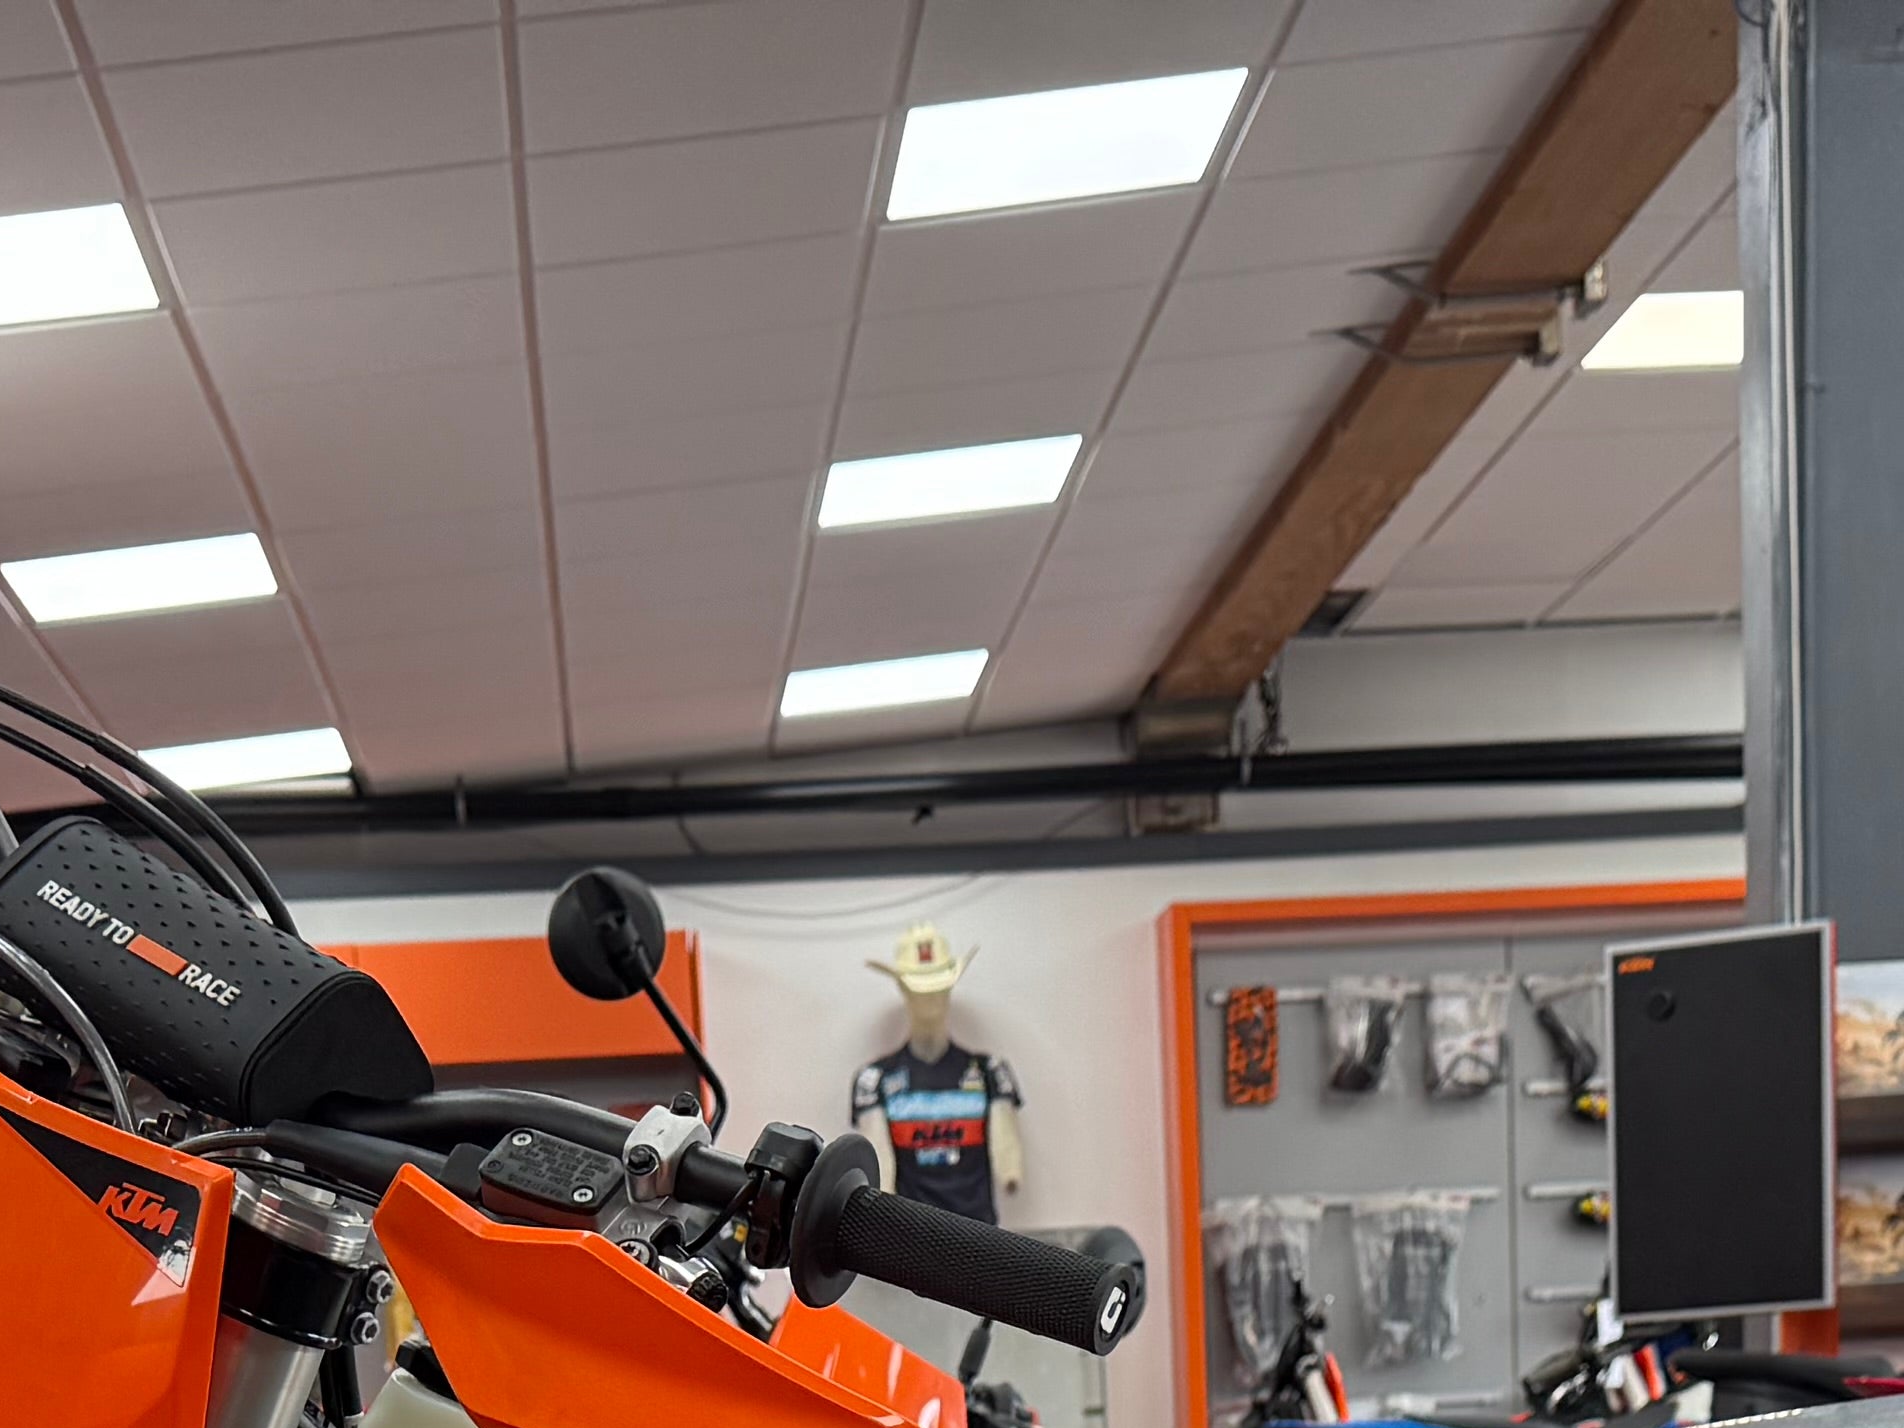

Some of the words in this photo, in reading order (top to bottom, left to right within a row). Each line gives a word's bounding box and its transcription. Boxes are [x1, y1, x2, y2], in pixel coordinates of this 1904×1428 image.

[36, 879, 109, 929] READY
[102, 917, 135, 945] TO
[177, 963, 242, 1007] RACE
[97, 1182, 180, 1237] KTM
